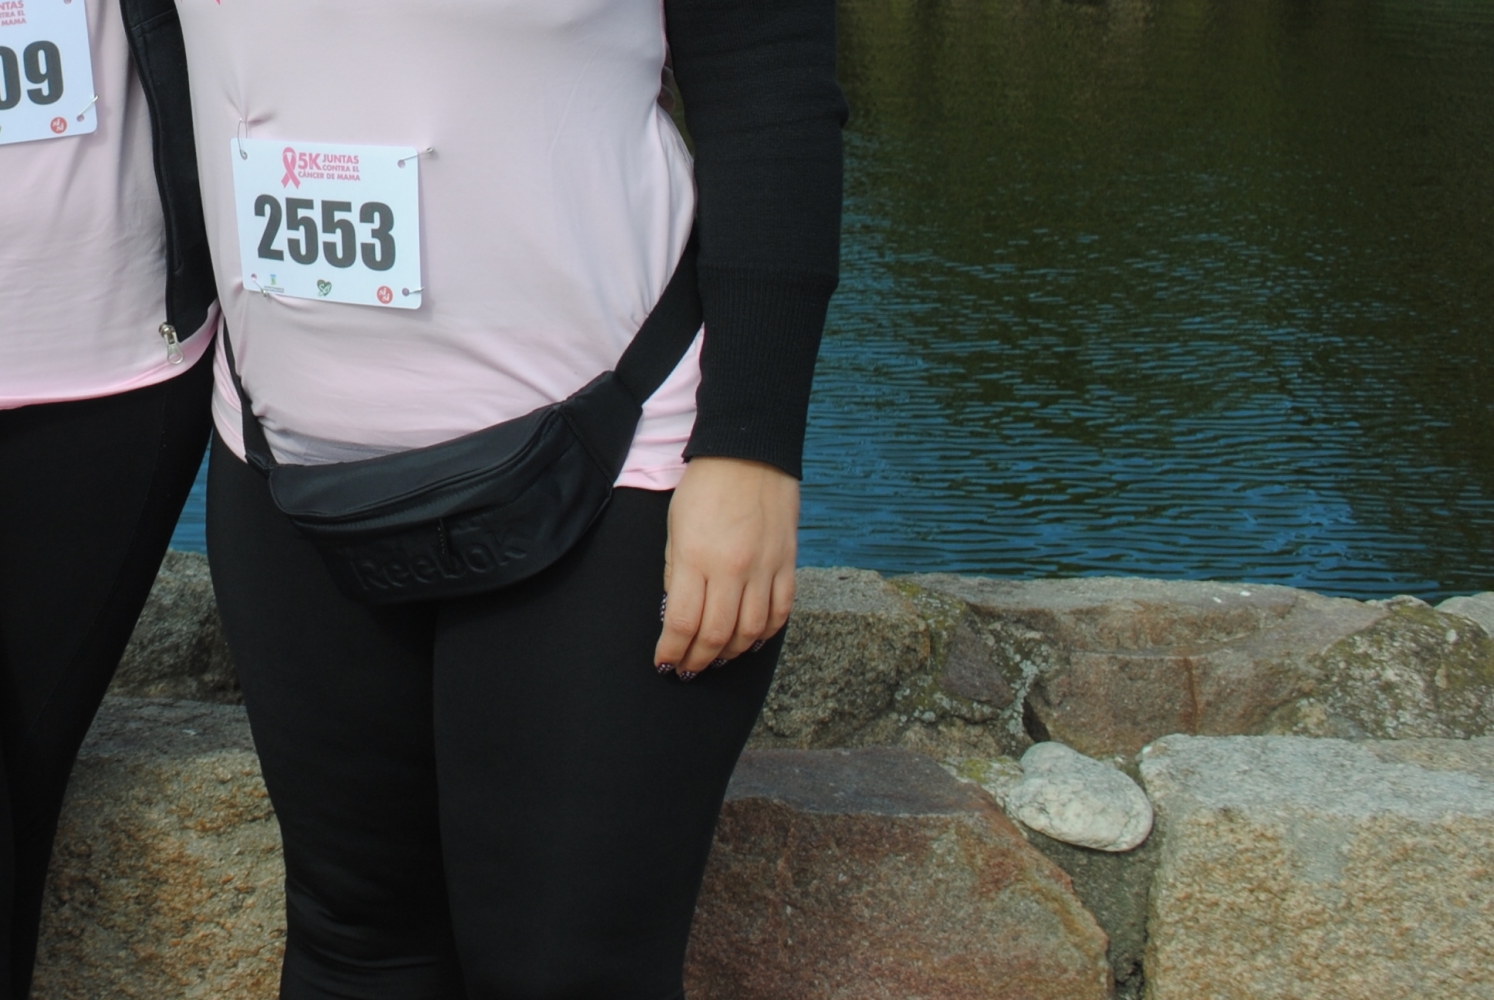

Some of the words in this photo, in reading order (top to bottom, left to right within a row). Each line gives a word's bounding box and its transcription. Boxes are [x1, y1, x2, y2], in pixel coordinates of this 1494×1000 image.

[1, 18, 26, 26] MAMA
[298, 152, 322, 171] 5K
[322, 153, 359, 164] JUNTAS
[322, 164, 351, 173] CONTRA
[352, 165, 360, 173] EL
[326, 172, 335, 180] DE
[337, 173, 361, 181] MAMA
[254, 193, 396, 272] 2553
